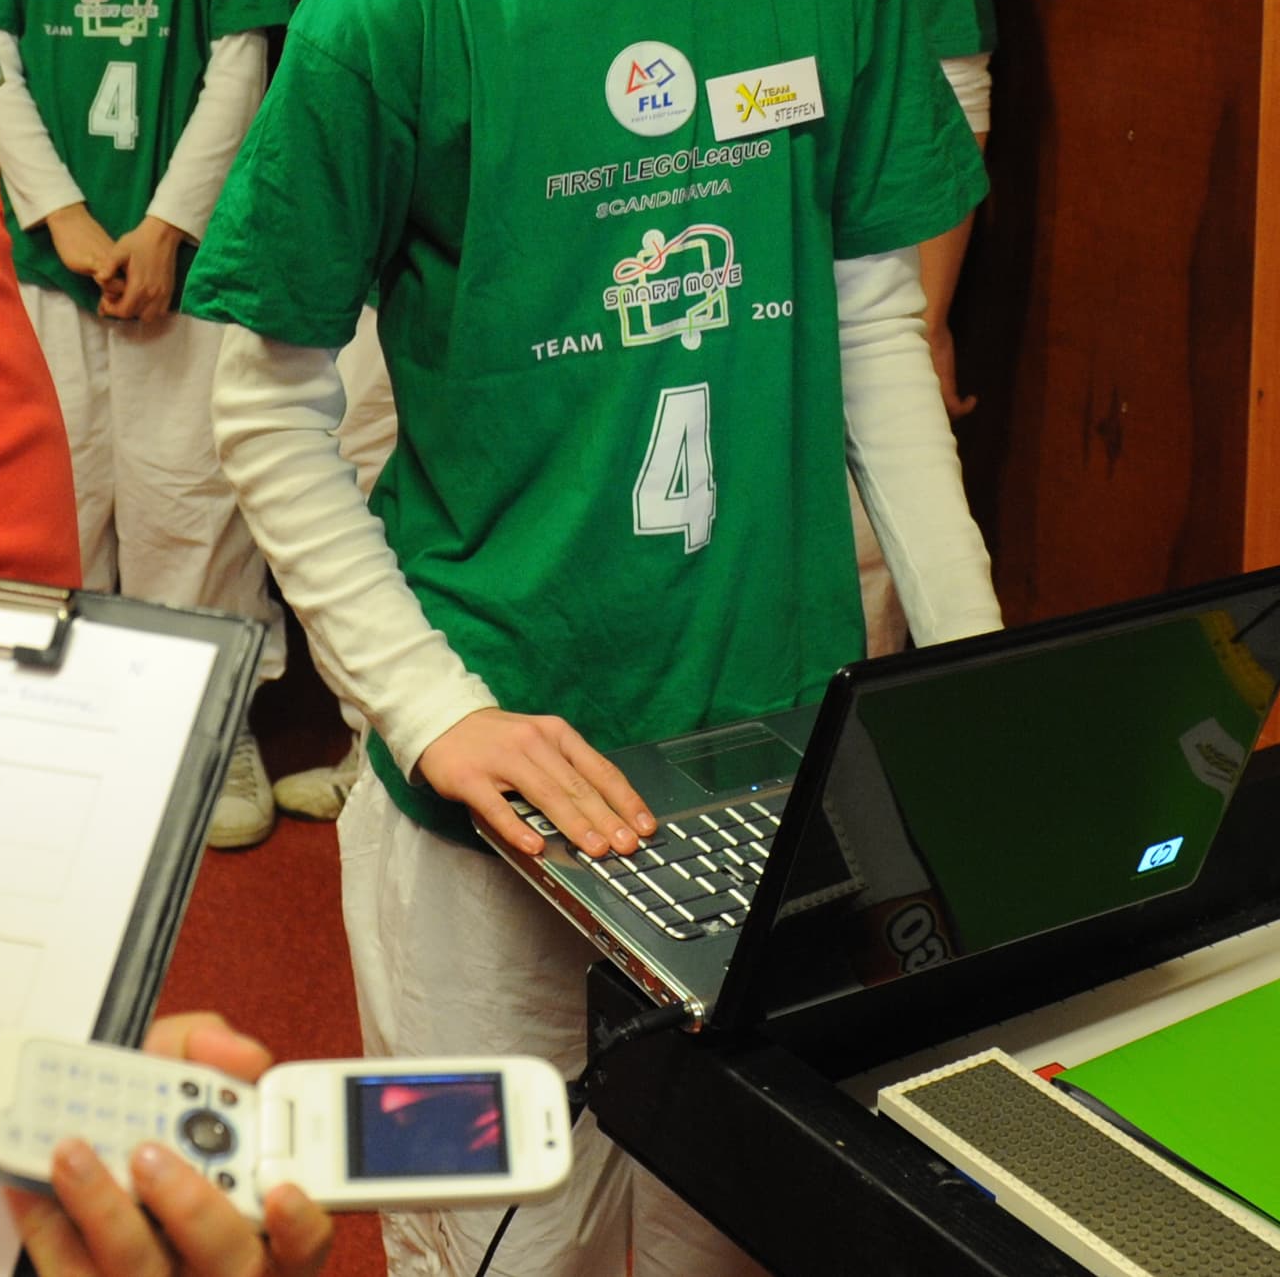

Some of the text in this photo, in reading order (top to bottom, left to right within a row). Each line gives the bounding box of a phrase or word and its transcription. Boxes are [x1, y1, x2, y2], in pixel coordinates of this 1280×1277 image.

[88, 60, 139, 150] 4
[639, 92, 673, 113] FLL
[762, 84, 791, 99] TEAM
[775, 102, 816, 123] STEFFEN
[546, 139, 772, 199] FIRST LEGO League
[603, 264, 742, 310] SMART MOVE
[751, 300, 794, 320] 200
[532, 333, 604, 362] TEAM
[632, 382, 717, 555] 4
